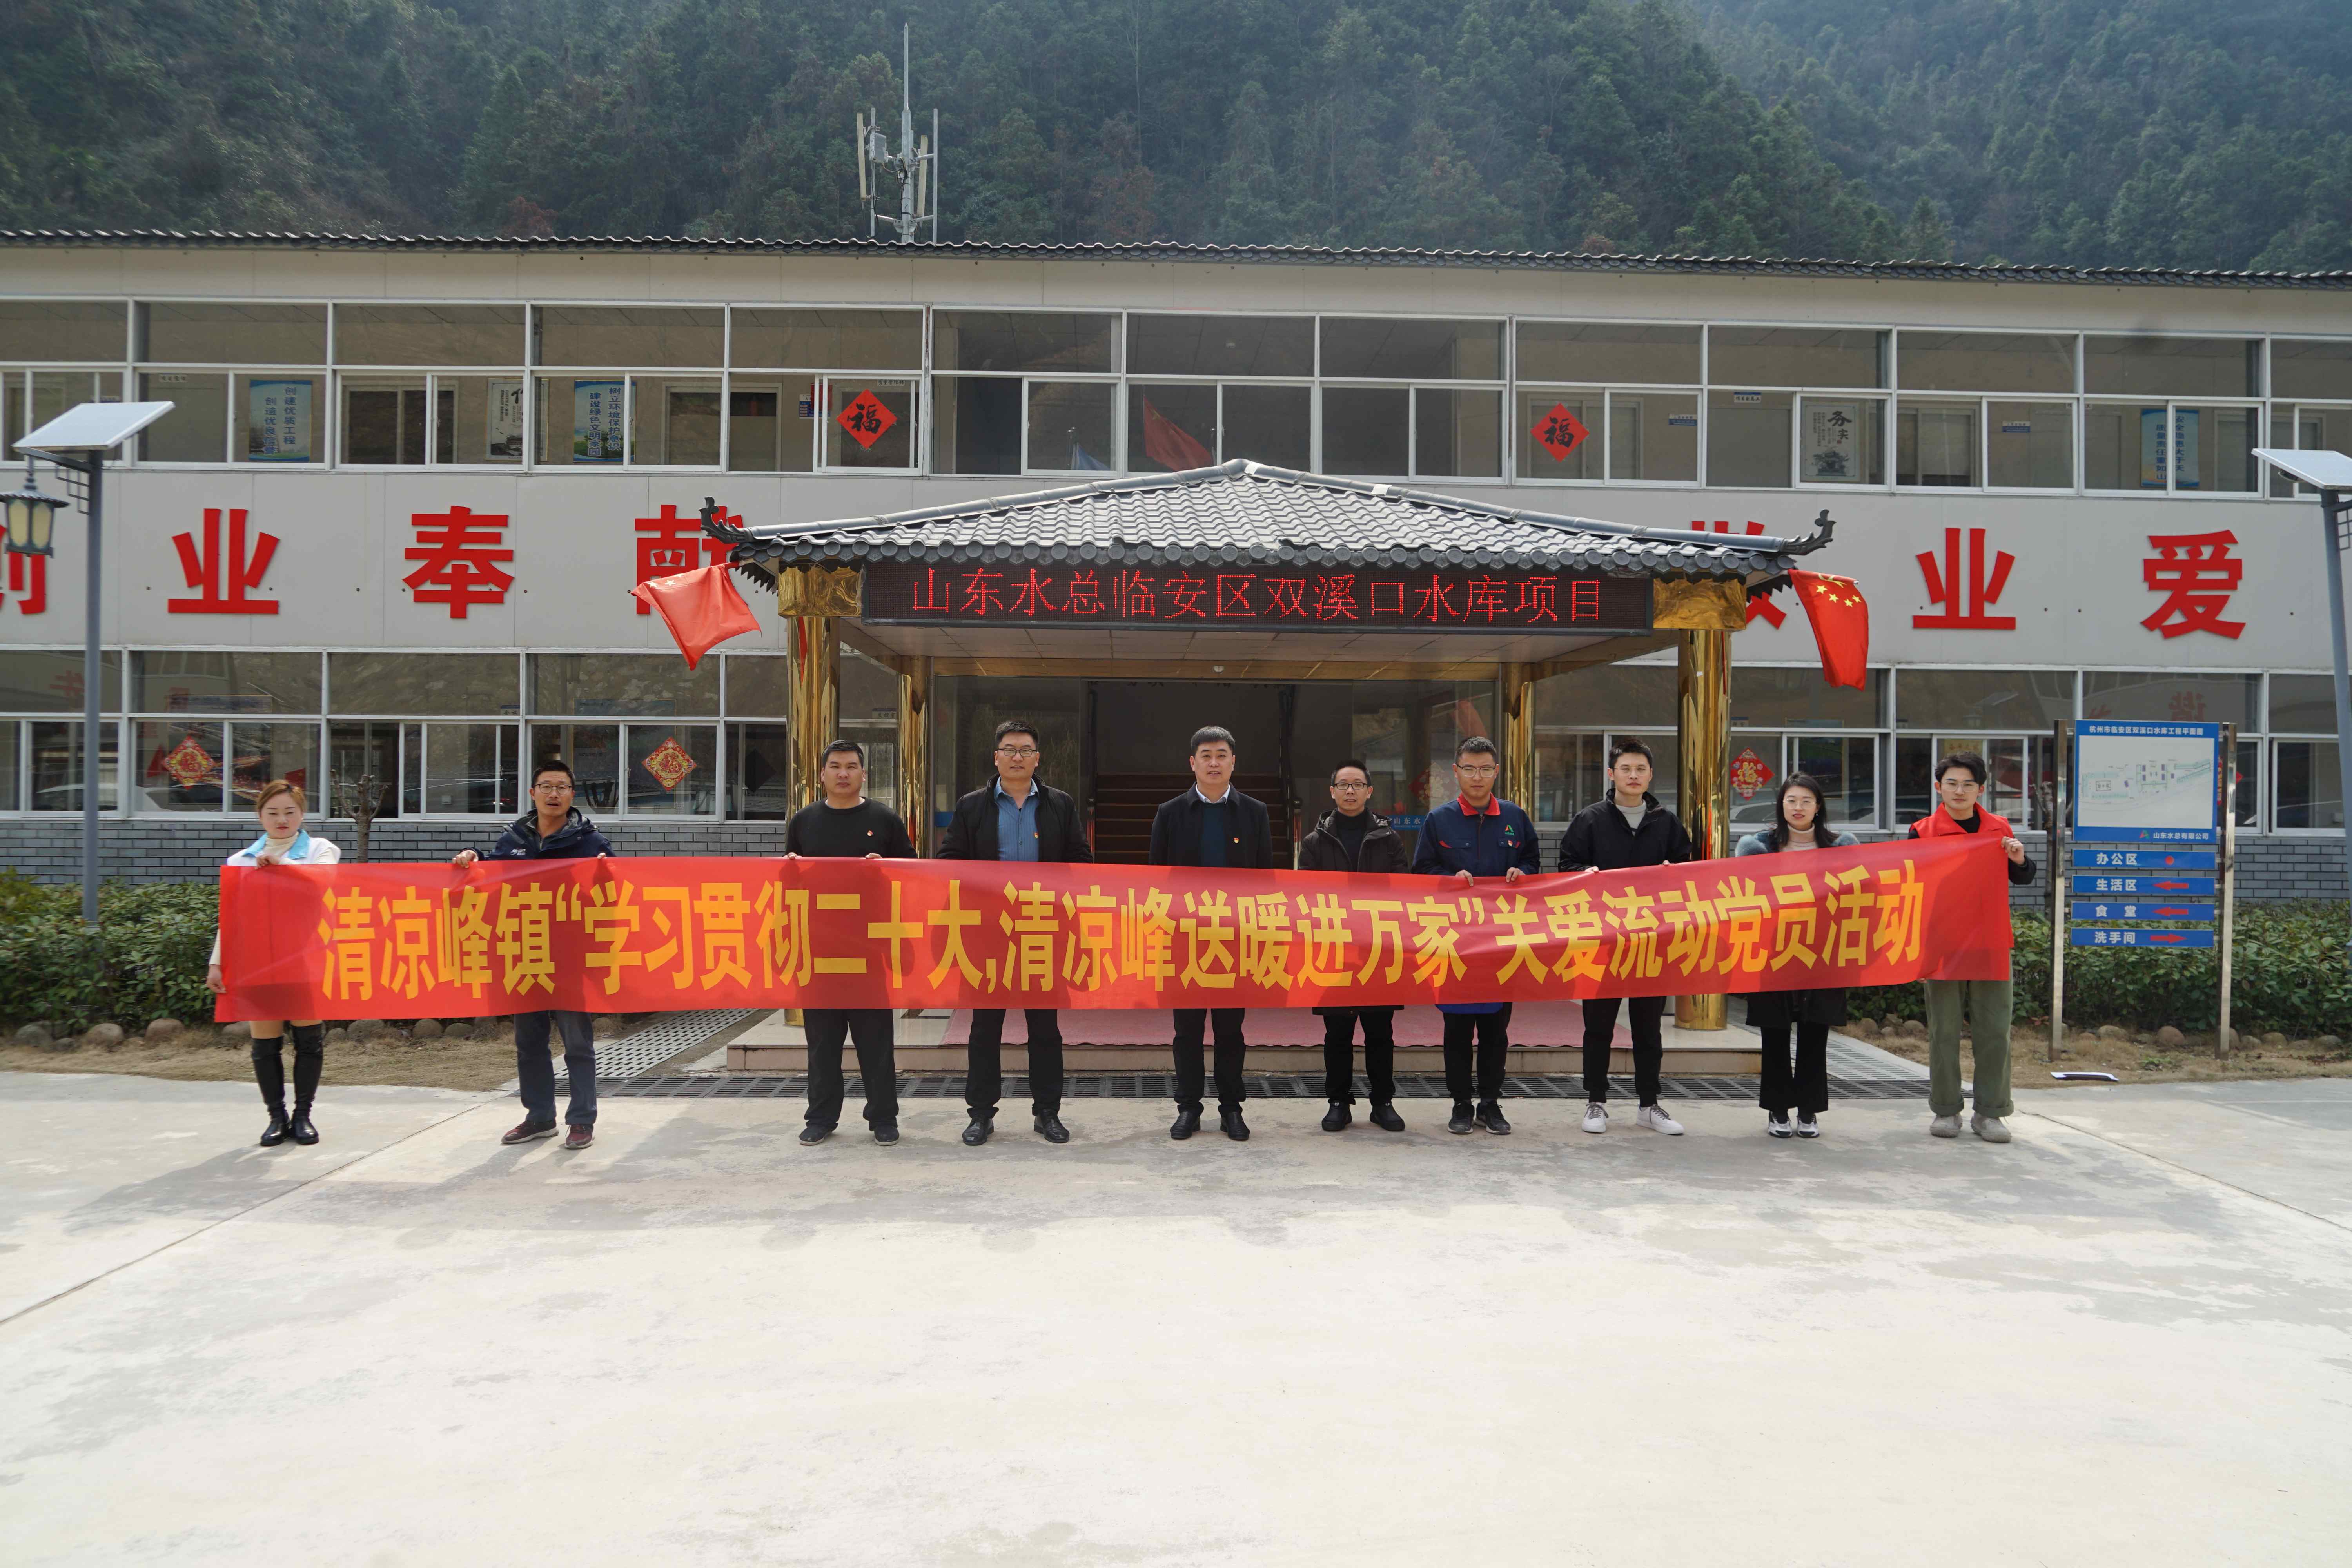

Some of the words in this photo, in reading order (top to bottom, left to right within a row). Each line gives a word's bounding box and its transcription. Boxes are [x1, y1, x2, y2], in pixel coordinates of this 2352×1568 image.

[283, 387, 296, 445] 创建优质工程
[588, 392, 602, 456] 建设绿色文明家园
[608, 387, 621, 451] 树立环境保护意识
[847, 403, 882, 434] 福
[1543, 416, 1574, 448] 福
[911, 568, 1601, 622] 山东水总临安区双溪口水库项目
[2089, 725, 2204, 735] 杭州市临安区双溪口水库工程平面图
[2153, 832, 2209, 840] 山东水总有限公司
[2096, 852, 2138, 865] 办公区
[2096, 878, 2137, 891] 生活区
[2094, 931, 2135, 944] 洗手间
